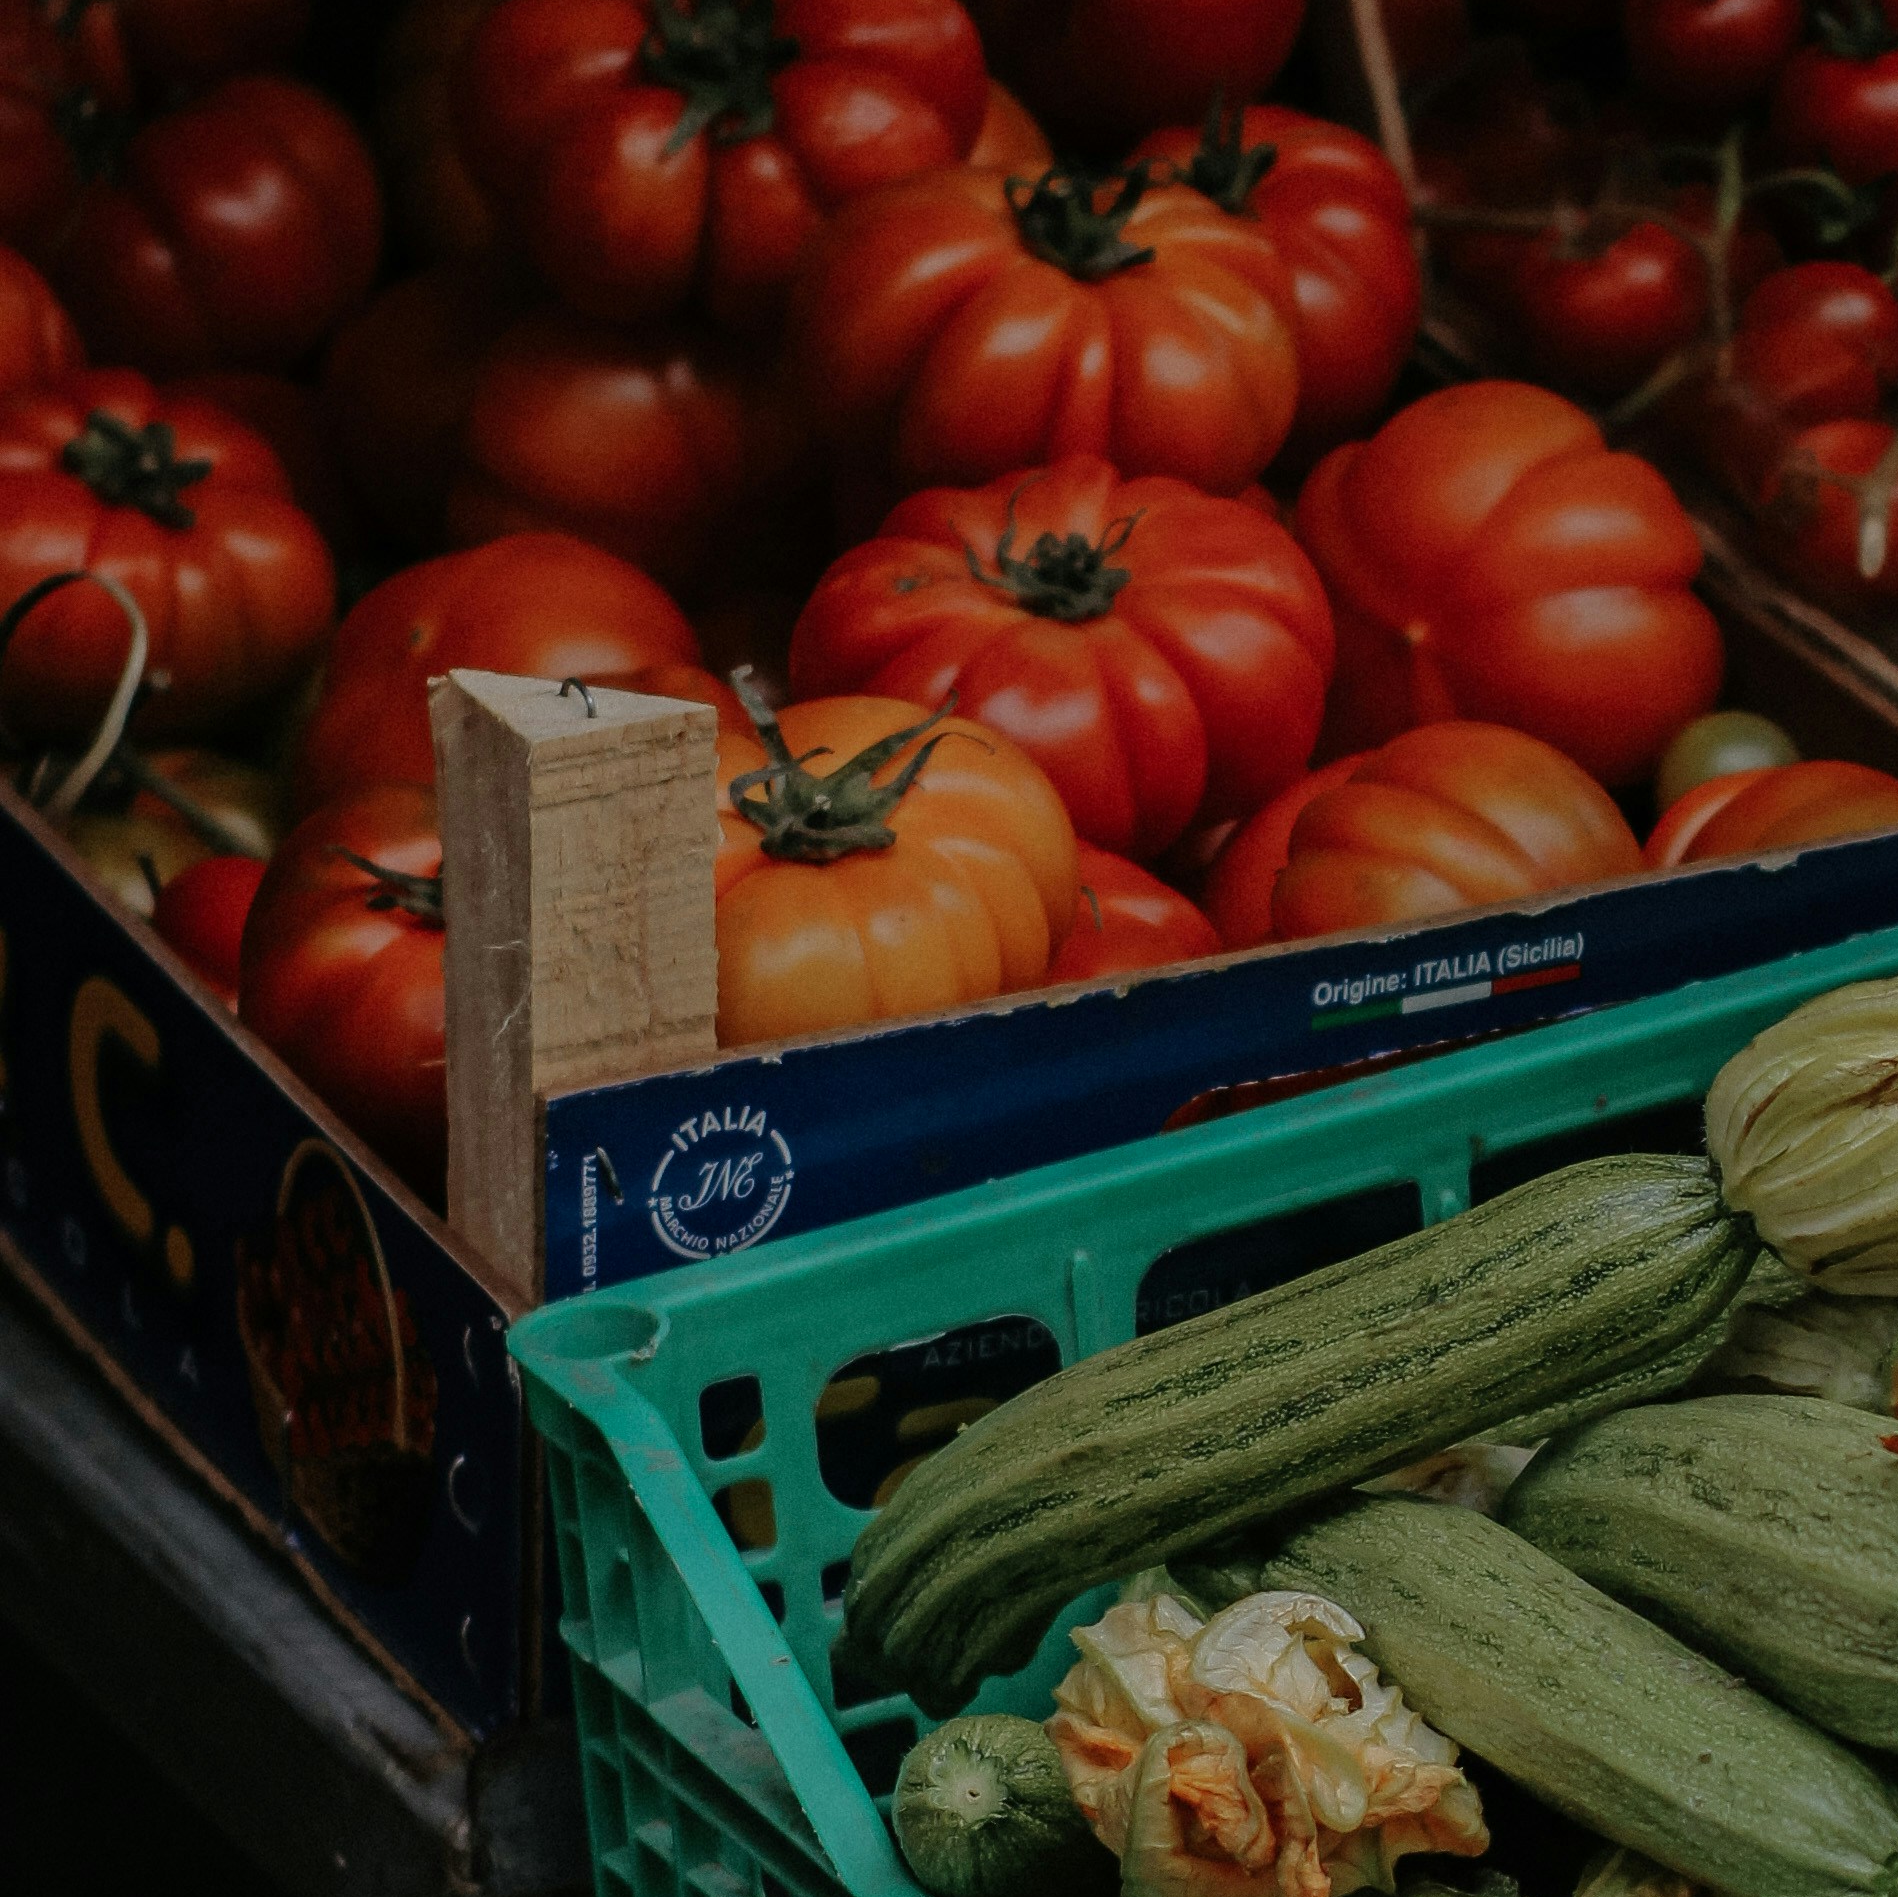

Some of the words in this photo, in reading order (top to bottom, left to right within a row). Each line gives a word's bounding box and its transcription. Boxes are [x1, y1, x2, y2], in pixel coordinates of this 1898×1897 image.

[1311, 971, 1408, 1007] Origine:
[1413, 950, 1492, 987] ITALIA
[1497, 931, 1585, 974] (Sicilia)
[671, 1105, 767, 1152] ITALIA
[659, 1195, 710, 1251] MARCHIO
[715, 1174, 785, 1250] NAZIONALE
[924, 1324, 1046, 1368] AZIEND
